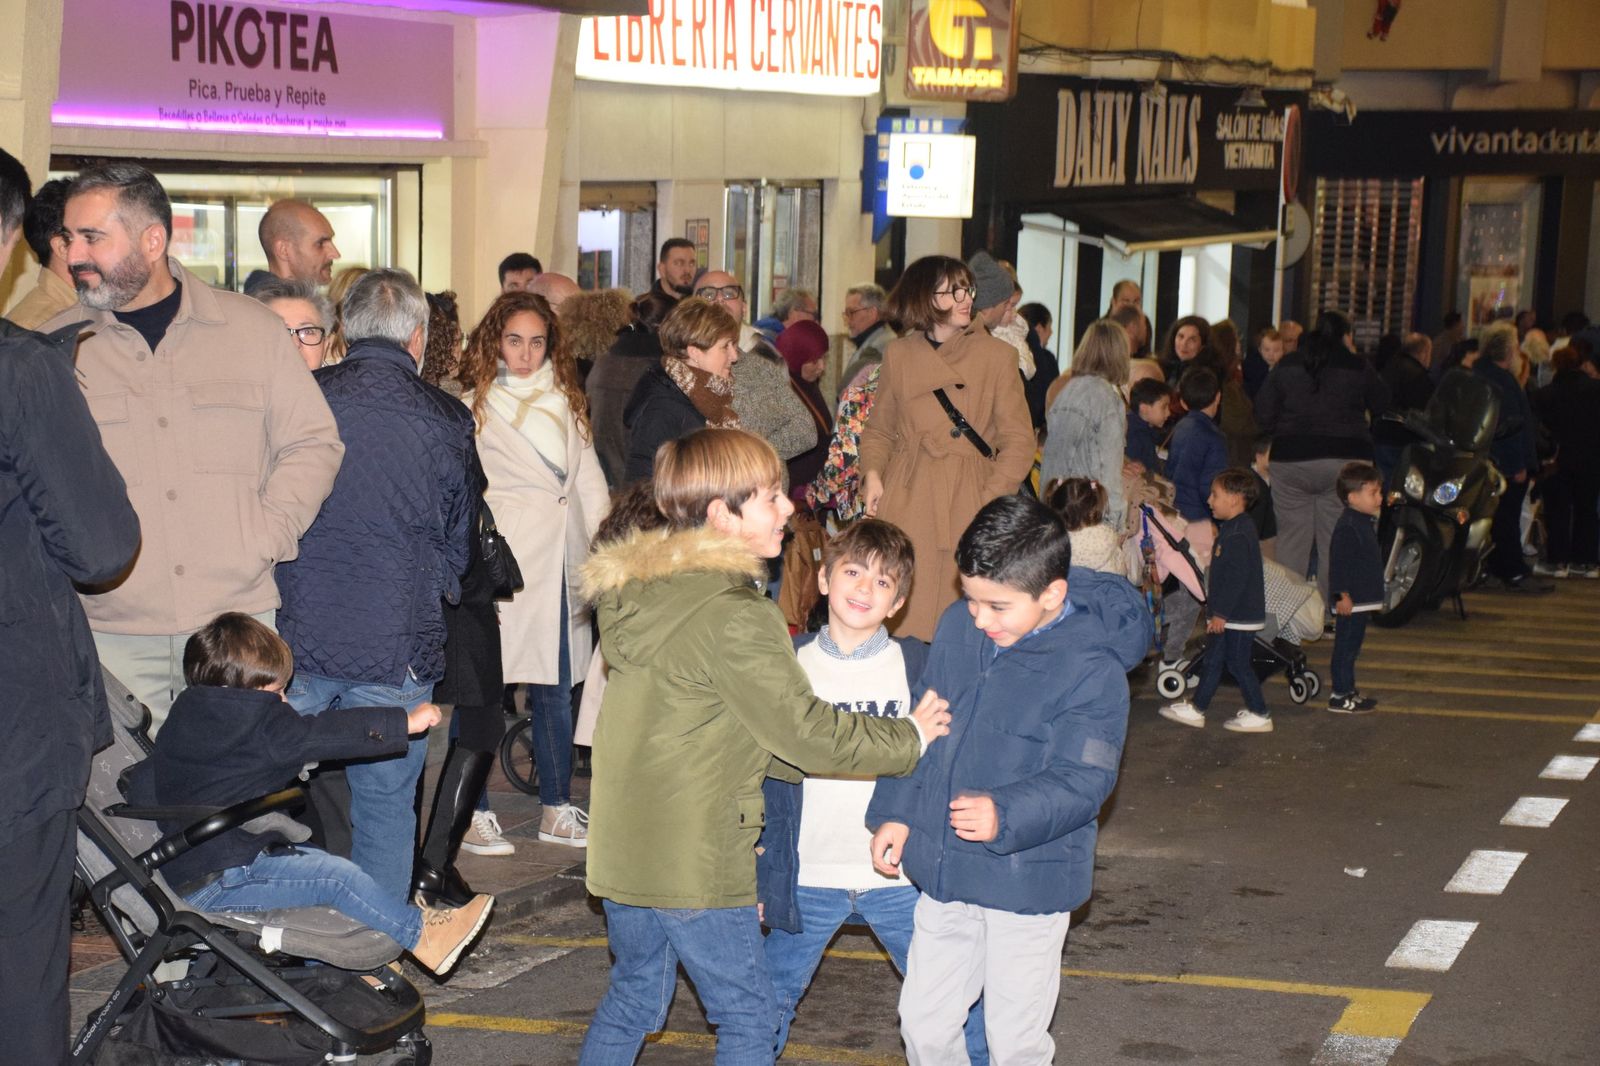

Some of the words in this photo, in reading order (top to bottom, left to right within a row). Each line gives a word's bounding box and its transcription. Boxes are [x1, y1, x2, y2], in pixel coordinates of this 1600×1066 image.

[171, 0, 338, 74] PIKOTEA
[750, 0, 881, 79] CERVANTES
[912, 66, 1003, 88] TABACOS
[189, 79, 221, 101] Pica,
[225, 82, 271, 103] Prueba
[274, 90, 283, 108] y
[286, 85, 326, 109] Repite
[1053, 88, 1133, 188] DAILY
[1135, 88, 1201, 185] NAILS
[1216, 107, 1248, 140] SALÓN
[1248, 113, 1262, 140] DE
[1224, 142, 1275, 169] VIETNAMITA
[83, 1023, 97, 1043] cool
